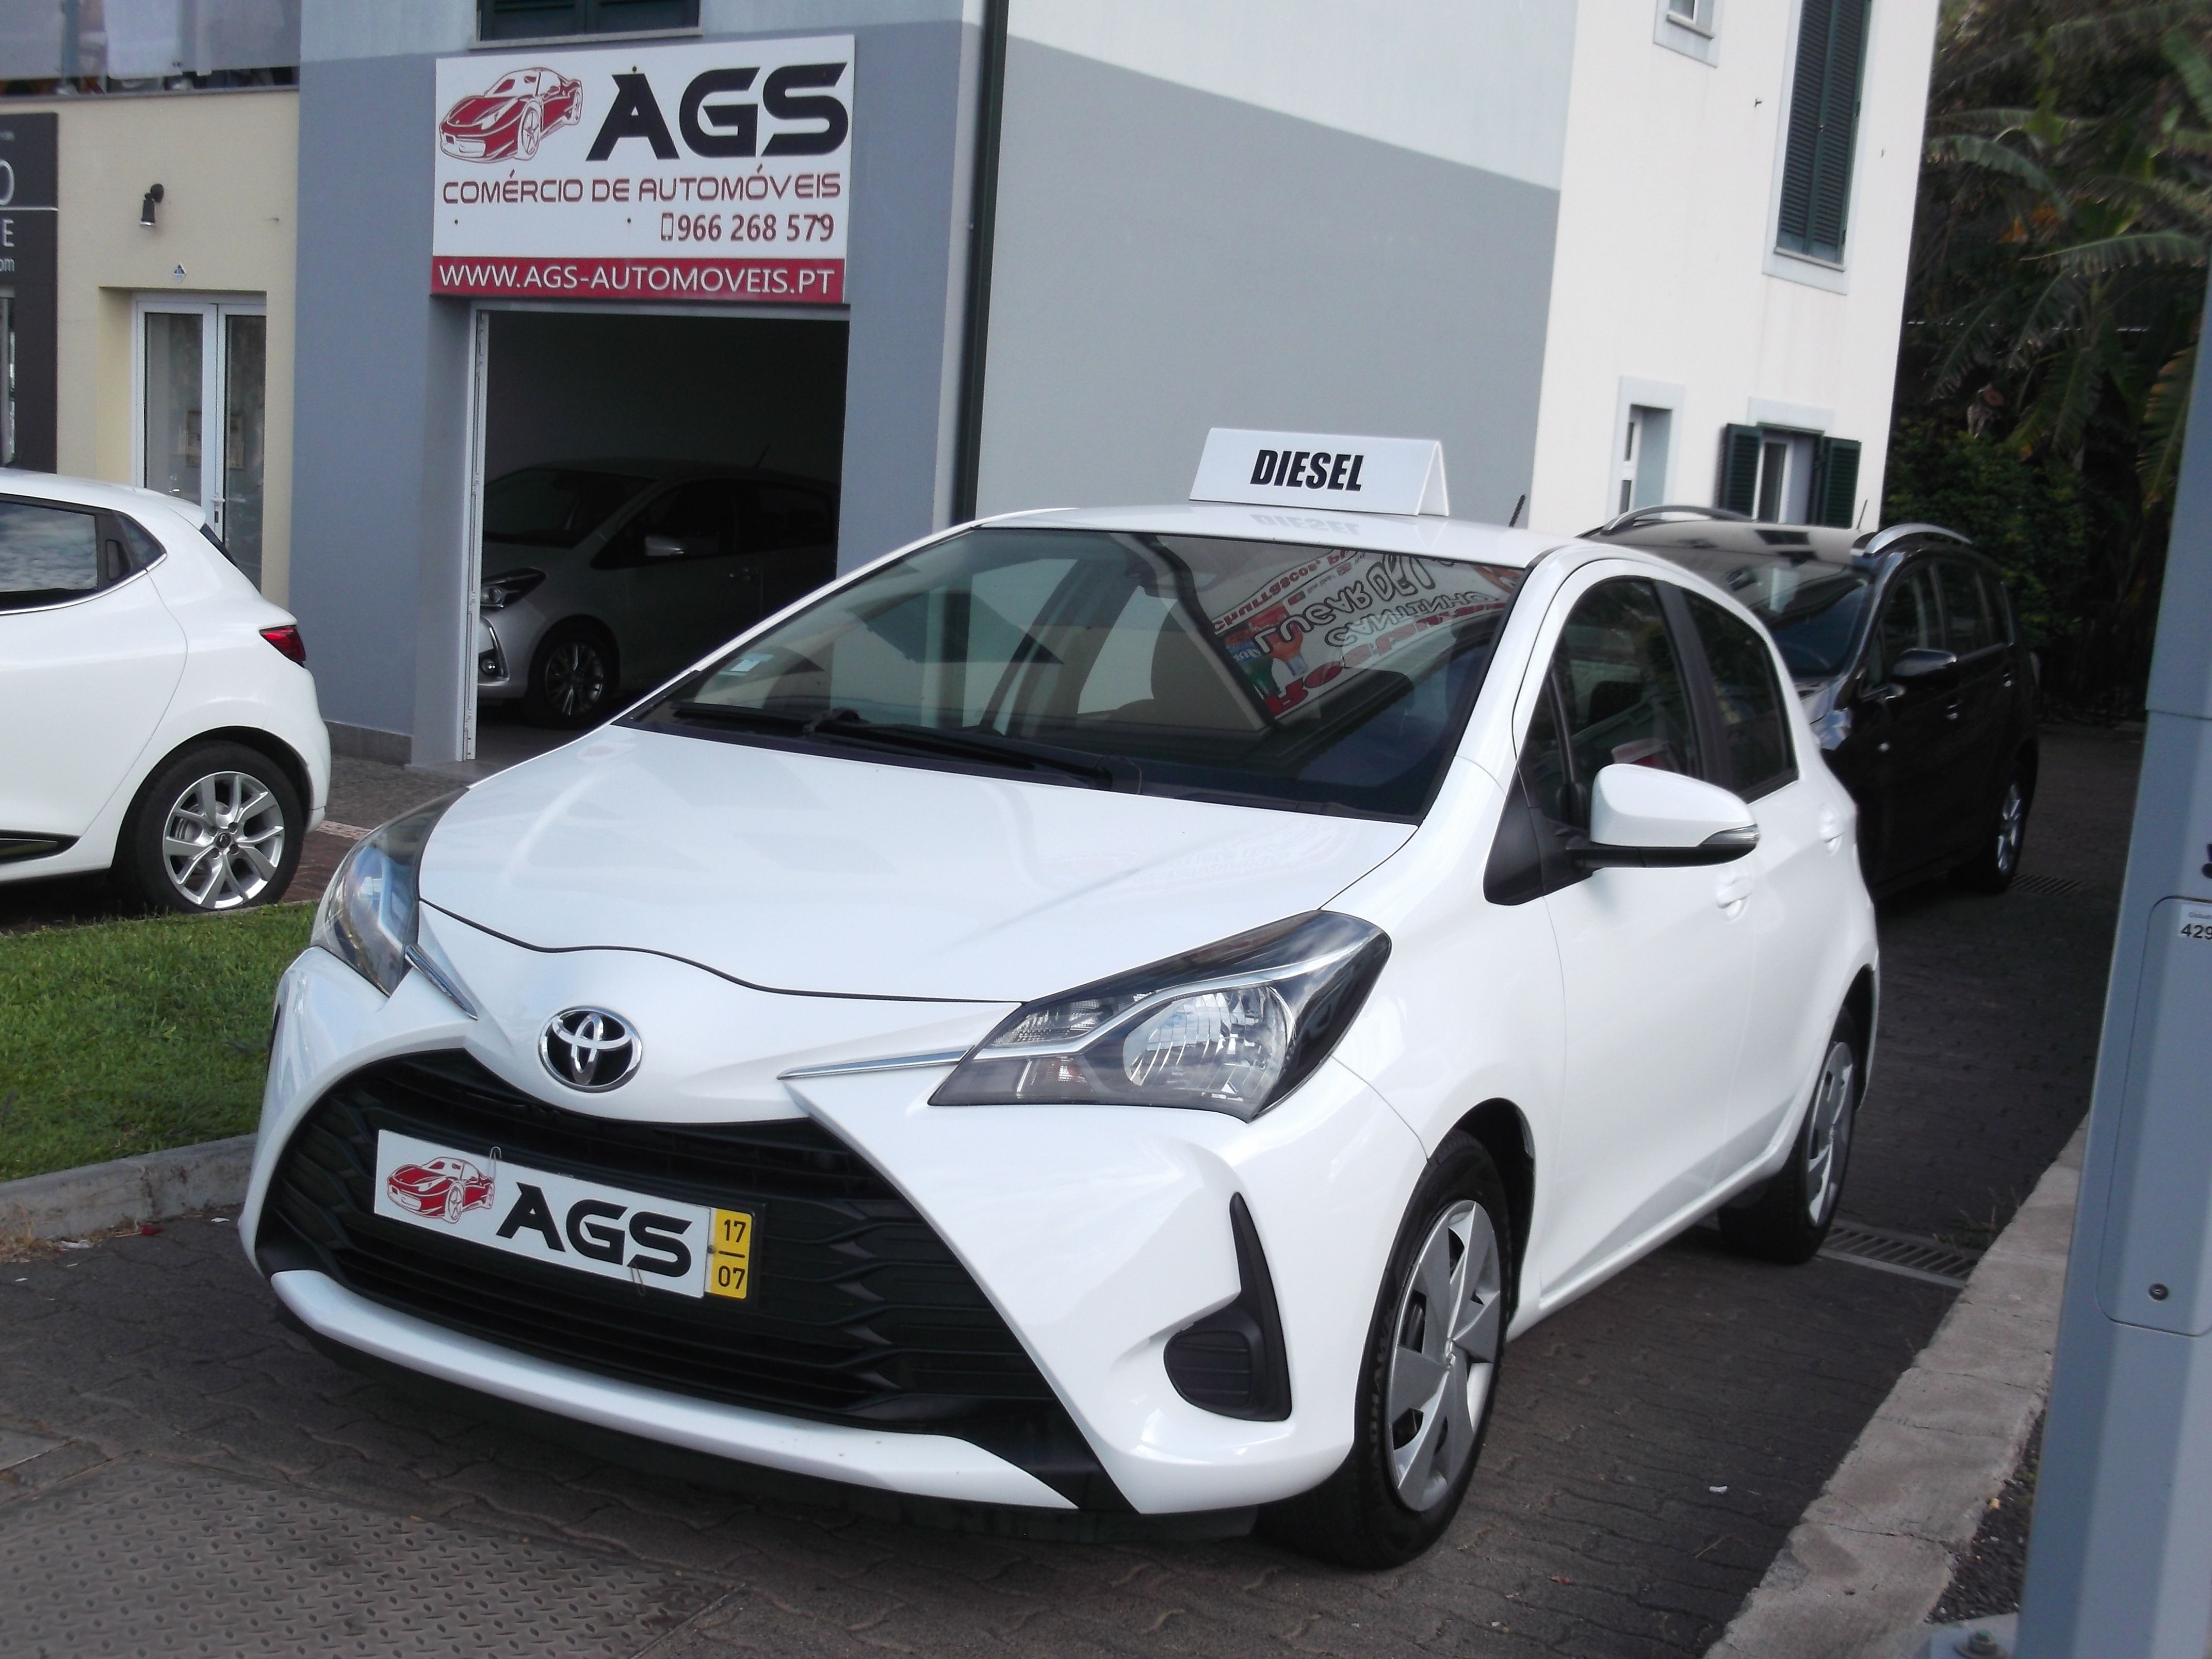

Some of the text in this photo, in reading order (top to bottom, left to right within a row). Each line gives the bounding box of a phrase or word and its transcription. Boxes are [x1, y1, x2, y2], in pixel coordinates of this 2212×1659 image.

[585, 63, 849, 161] AGS
[443, 164, 841, 204] COMÉRCIO DE AUTOMÓVEIS
[678, 214, 835, 243] 966 268 579
[440, 264, 835, 295] WWW.AGS-AUTOMOVEIS.PT
[1249, 449, 1364, 492] DIESEL
[495, 1181, 693, 1279] AGS
[723, 1218, 747, 1244] 17
[718, 1265, 746, 1290] 07
